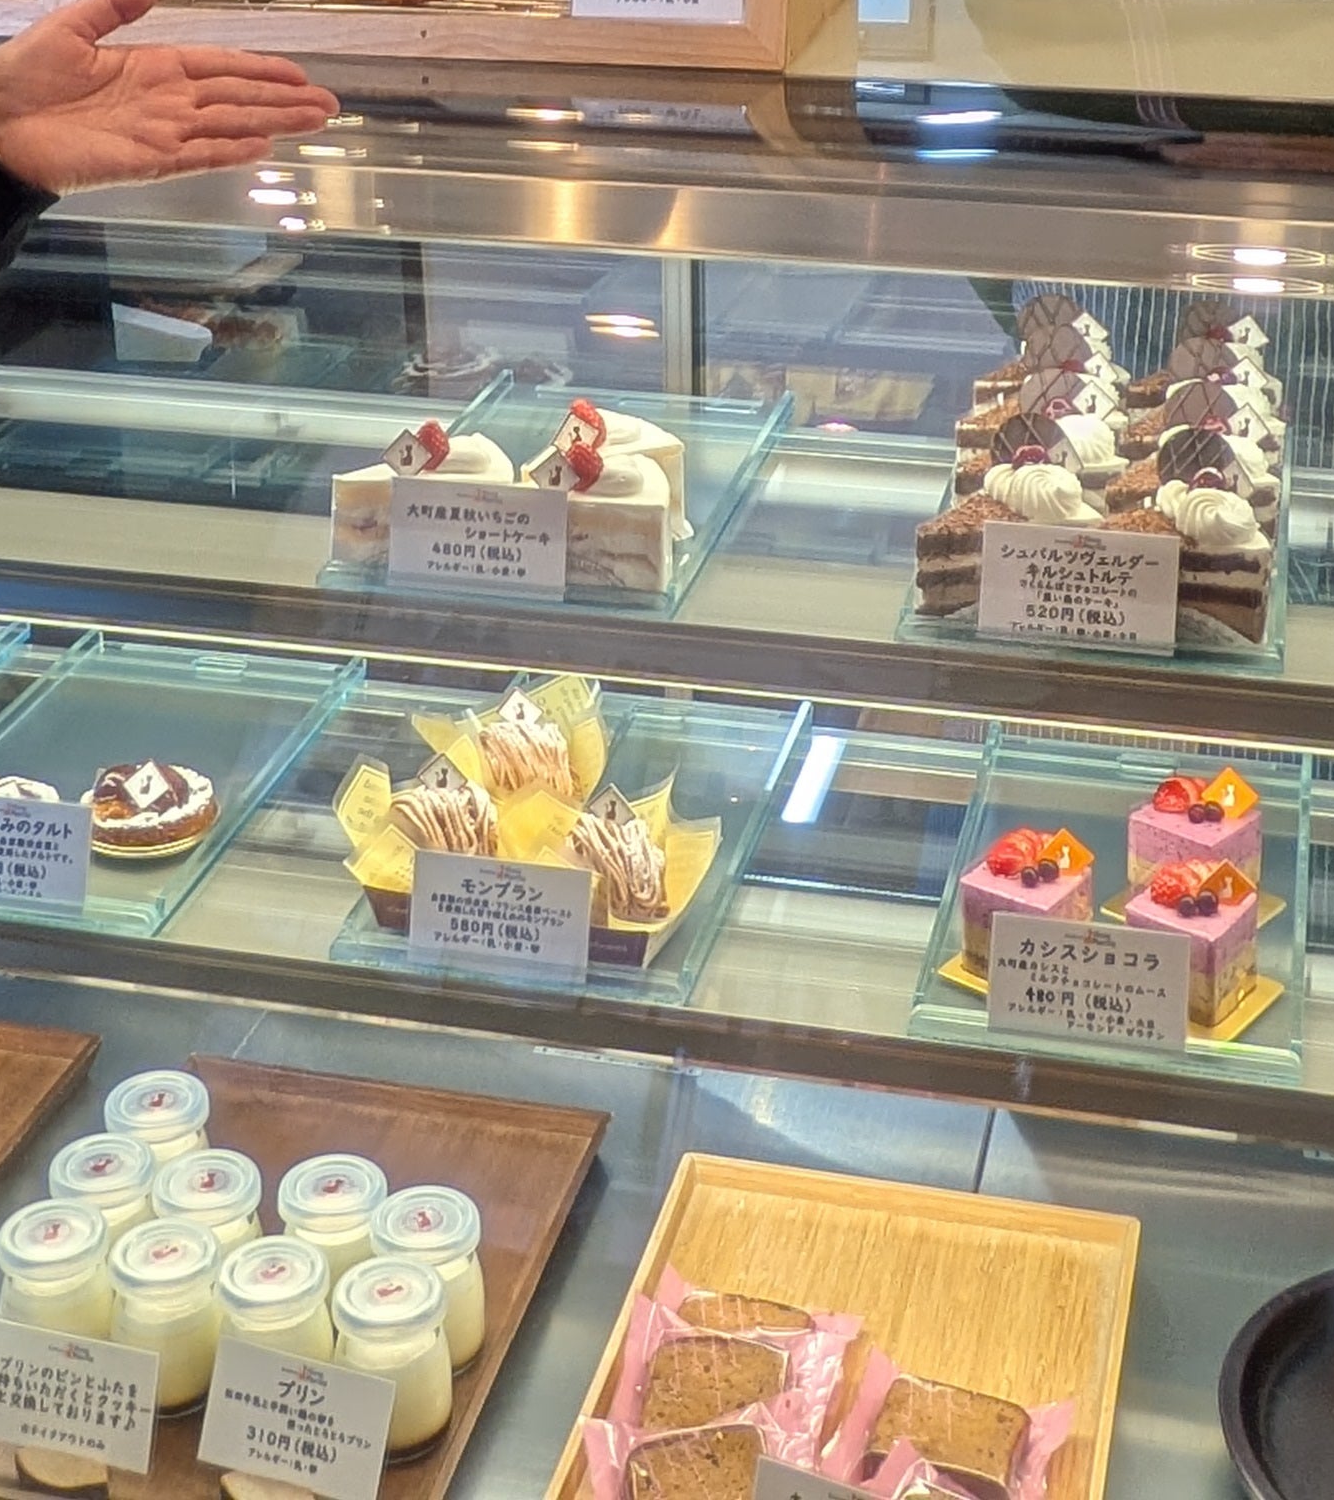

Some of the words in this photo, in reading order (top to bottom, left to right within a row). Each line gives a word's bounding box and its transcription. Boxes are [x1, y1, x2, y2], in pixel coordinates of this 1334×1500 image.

[407, 503, 530, 526] 大町産夏秋いちごの
[464, 527, 551, 546] ショートケーキ
[1000, 544, 1159, 569] シュバルツヴェルダー
[1025, 563, 1133, 585] キルシュトルテ
[461, 878, 543, 902] モンブラン
[1019, 938, 1160, 971] カシスショコラ
[1030, 972, 1167, 998] ミルクチョコレートのムース
[278, 1380, 325, 1406] プリン
